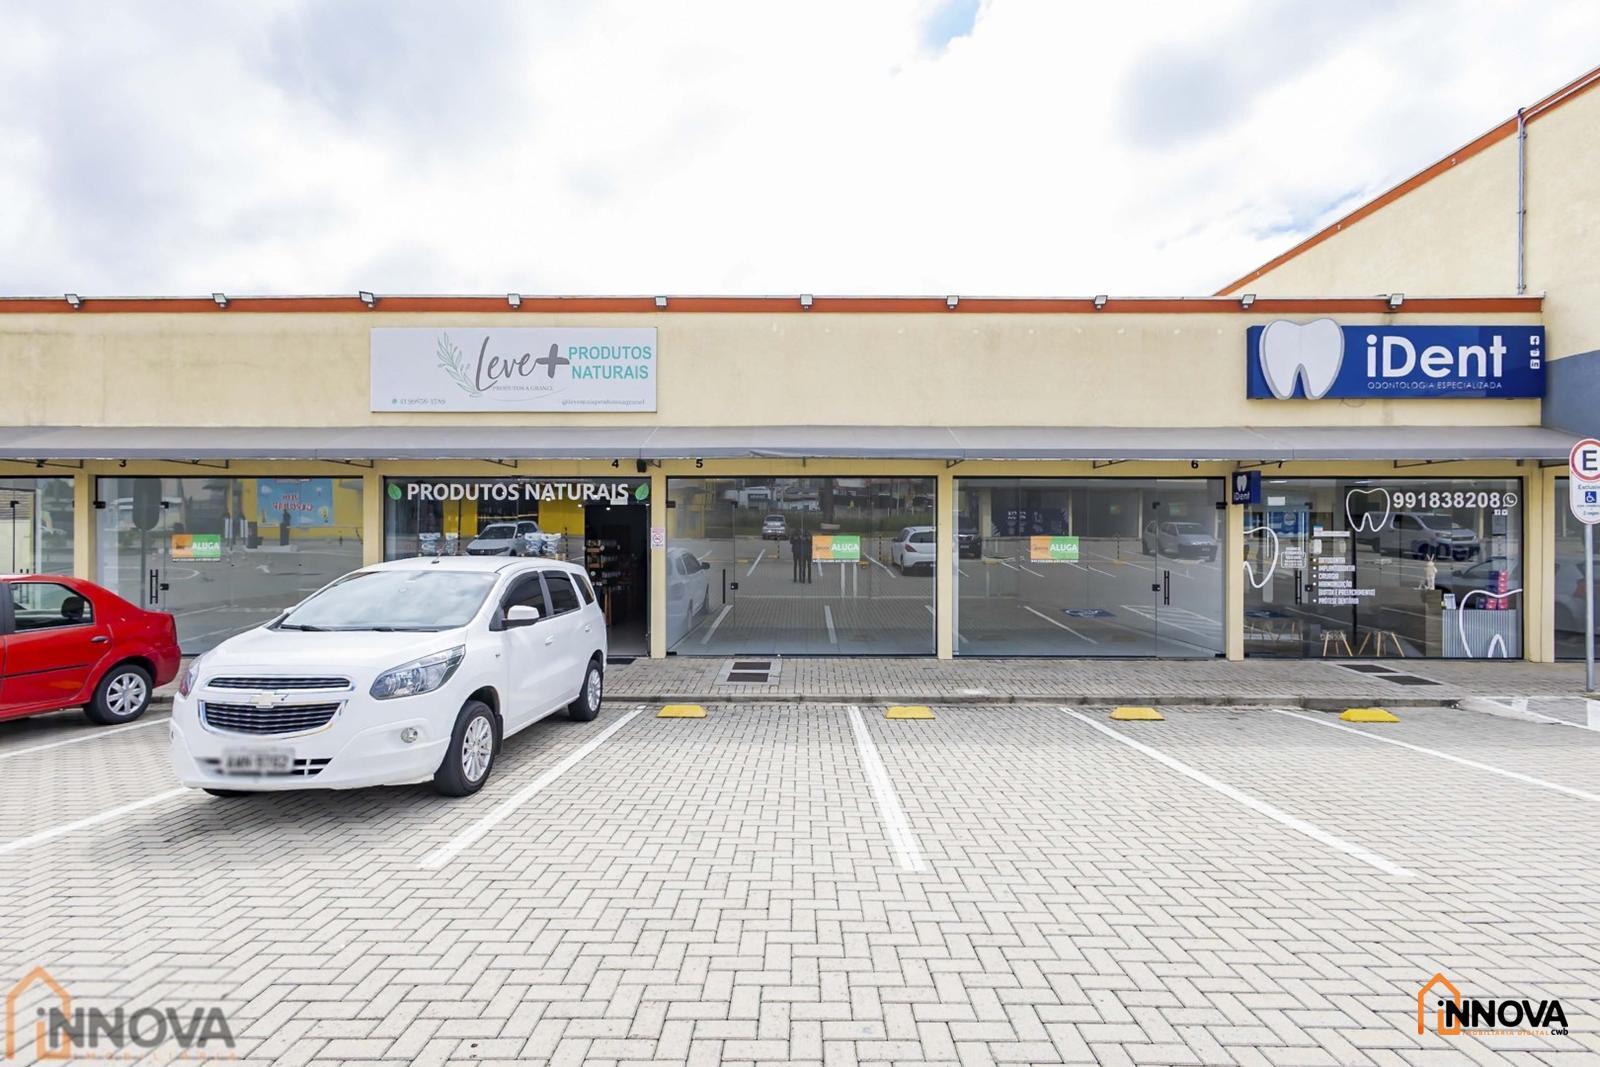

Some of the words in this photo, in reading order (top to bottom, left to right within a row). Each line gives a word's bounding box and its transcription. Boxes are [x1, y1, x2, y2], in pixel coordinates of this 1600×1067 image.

[568, 345, 652, 361] PRODUTOS
[1366, 334, 1507, 378] iDent
[571, 365, 649, 380] NATURAIS
[1367, 381, 1435, 390] ODONTOLOGIA
[1437, 381, 1503, 390] ESPECIALIZADA
[119, 459, 127, 468] 3
[611, 459, 619, 468] 4
[695, 459, 704, 469] 5
[1191, 460, 1199, 469] 6
[1582, 450, 1598, 471] E
[407, 483, 519, 501] PRODUTOS
[525, 483, 629, 501] NATURAIS
[1393, 492, 1501, 509] 991838208
[192, 541, 219, 551] ALUGA
[831, 543, 859, 552] ALUGA
[1049, 543, 1078, 552] ALUGA
